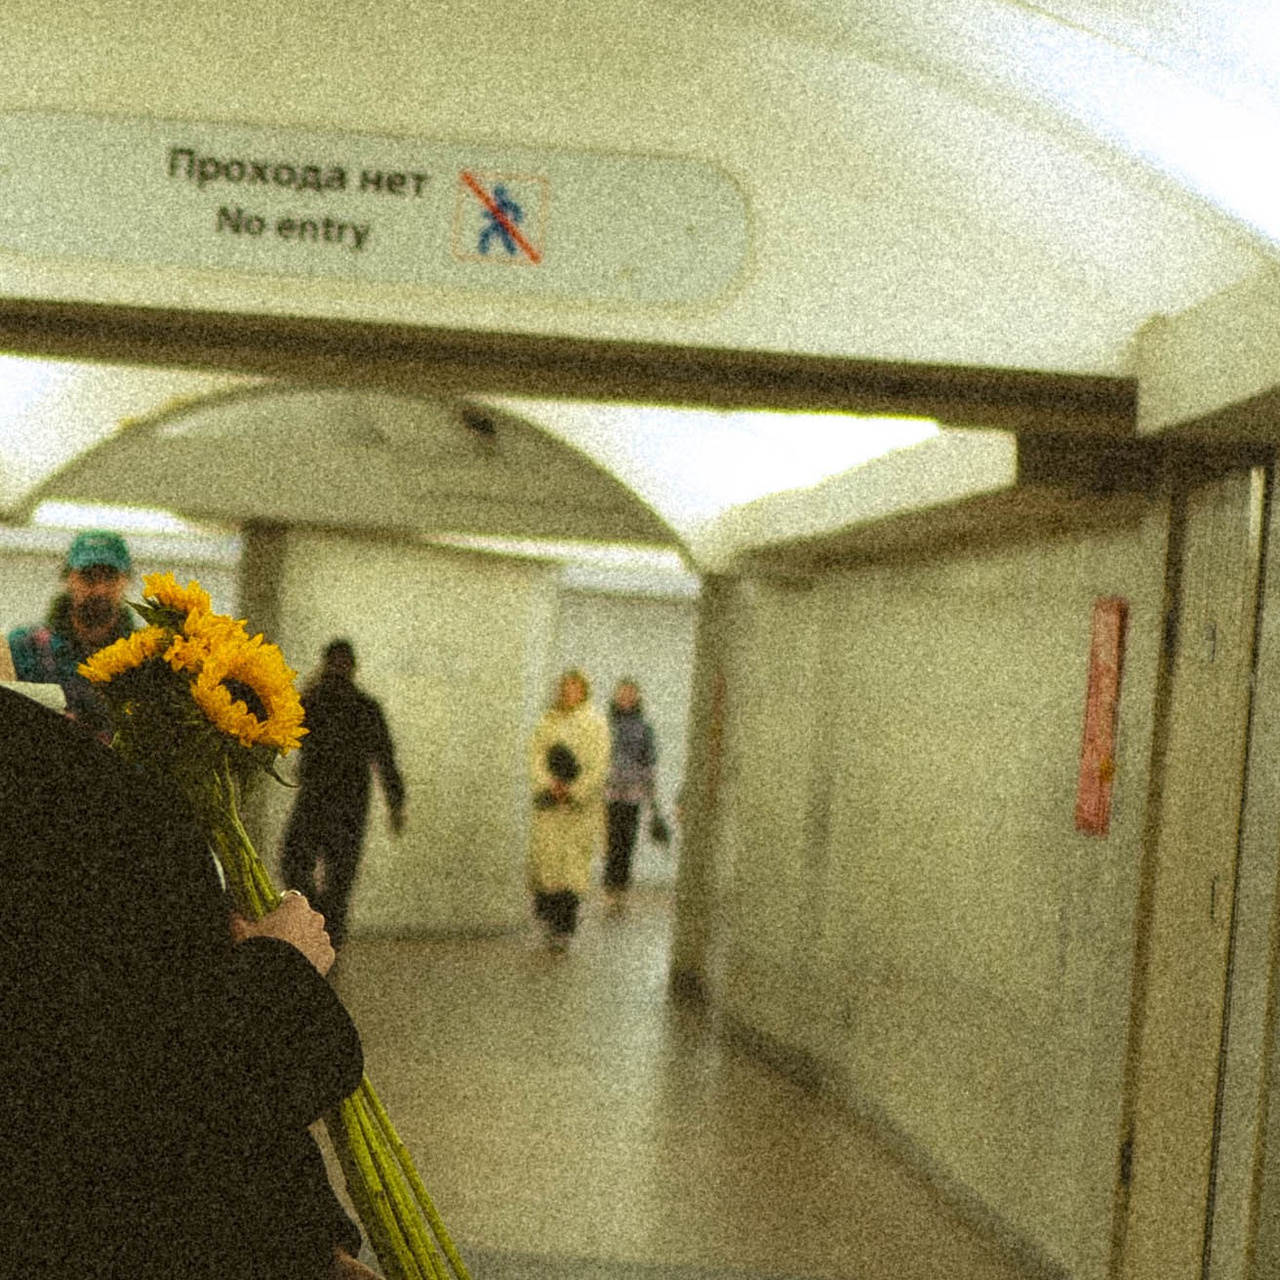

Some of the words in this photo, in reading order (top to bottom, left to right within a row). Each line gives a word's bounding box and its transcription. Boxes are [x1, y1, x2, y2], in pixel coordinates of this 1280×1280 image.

[169, 147, 347, 191] Прохода
[360, 168, 430, 197] нет
[217, 206, 266, 236] No
[277, 216, 370, 250] entry
